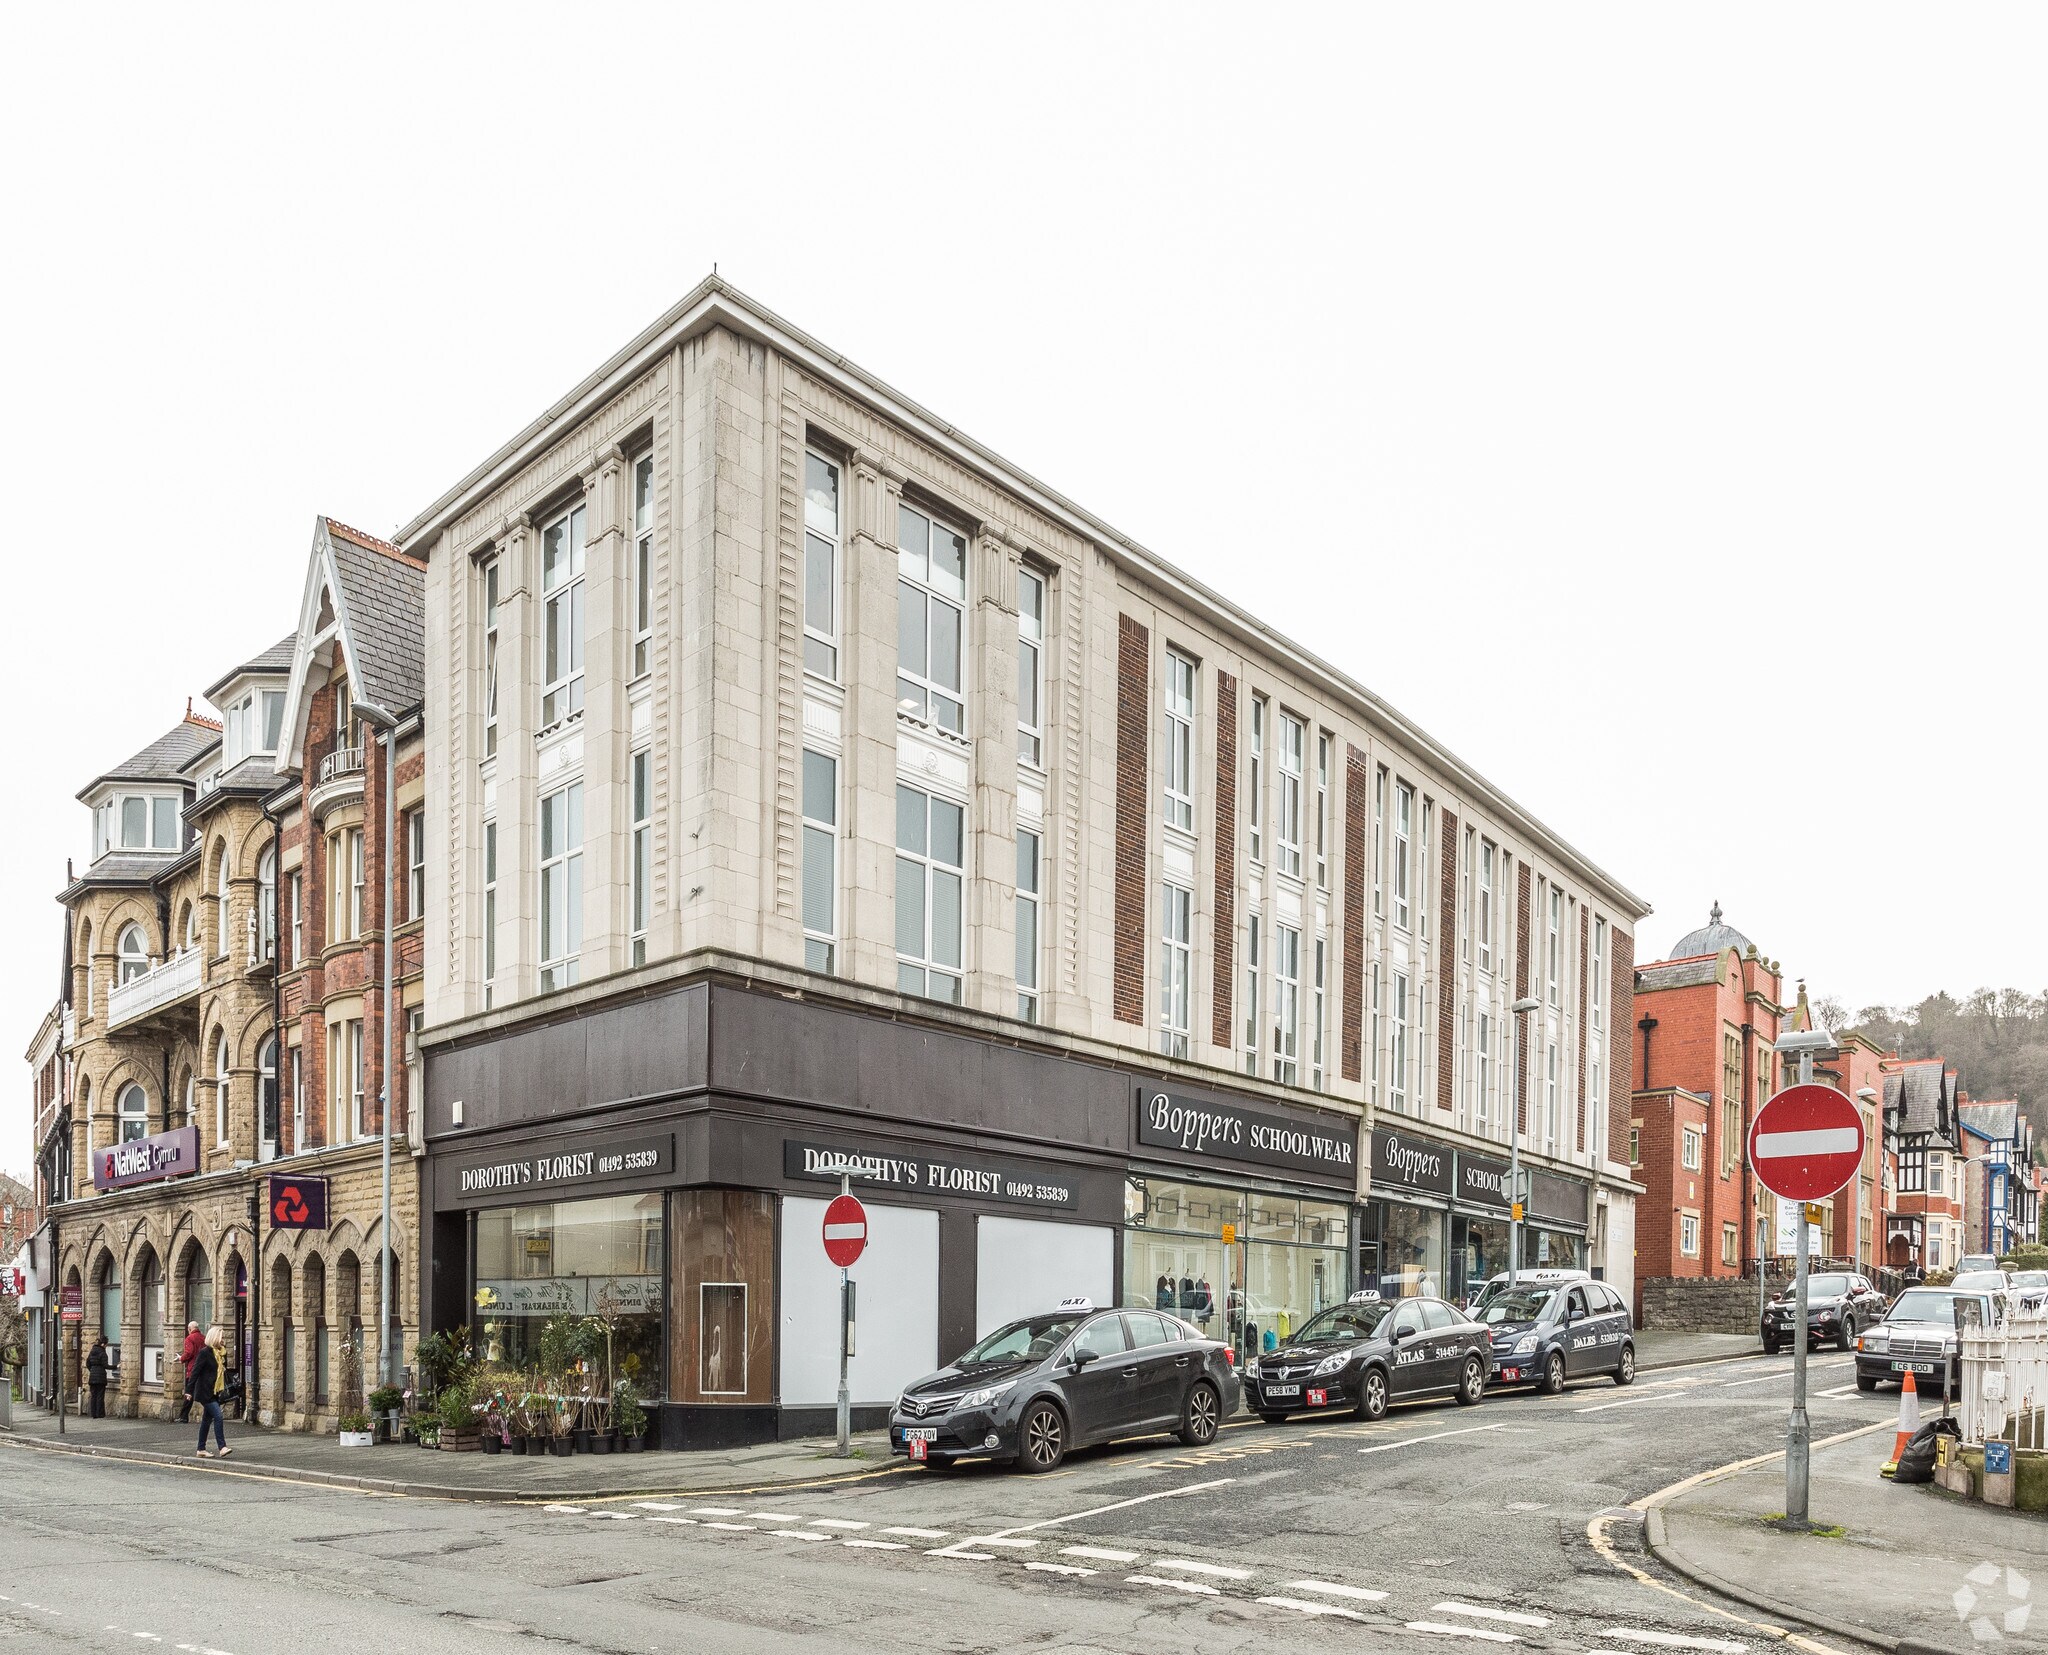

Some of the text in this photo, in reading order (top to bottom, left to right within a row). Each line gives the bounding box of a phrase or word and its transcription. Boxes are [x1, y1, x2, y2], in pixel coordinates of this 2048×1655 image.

[1149, 1093, 1352, 1164] Boppers SCHOOLWEAR
[114, 1143, 177, 1178] NatWest Cymru
[461, 1150, 658, 1191] DOROTHY'S FLORIST 01492 535839
[803, 1148, 1068, 1202] DOROTHY'S FLORIST 01492 535839
[1385, 1136, 1440, 1184] Boppers
[1466, 1167, 1503, 1192] SCHOOL
[1060, 1297, 1086, 1307] TAXI
[1353, 1291, 1376, 1299] TAXI
[1573, 1335, 1597, 1349] DALES
[1395, 1350, 1425, 1365] ATLAS
